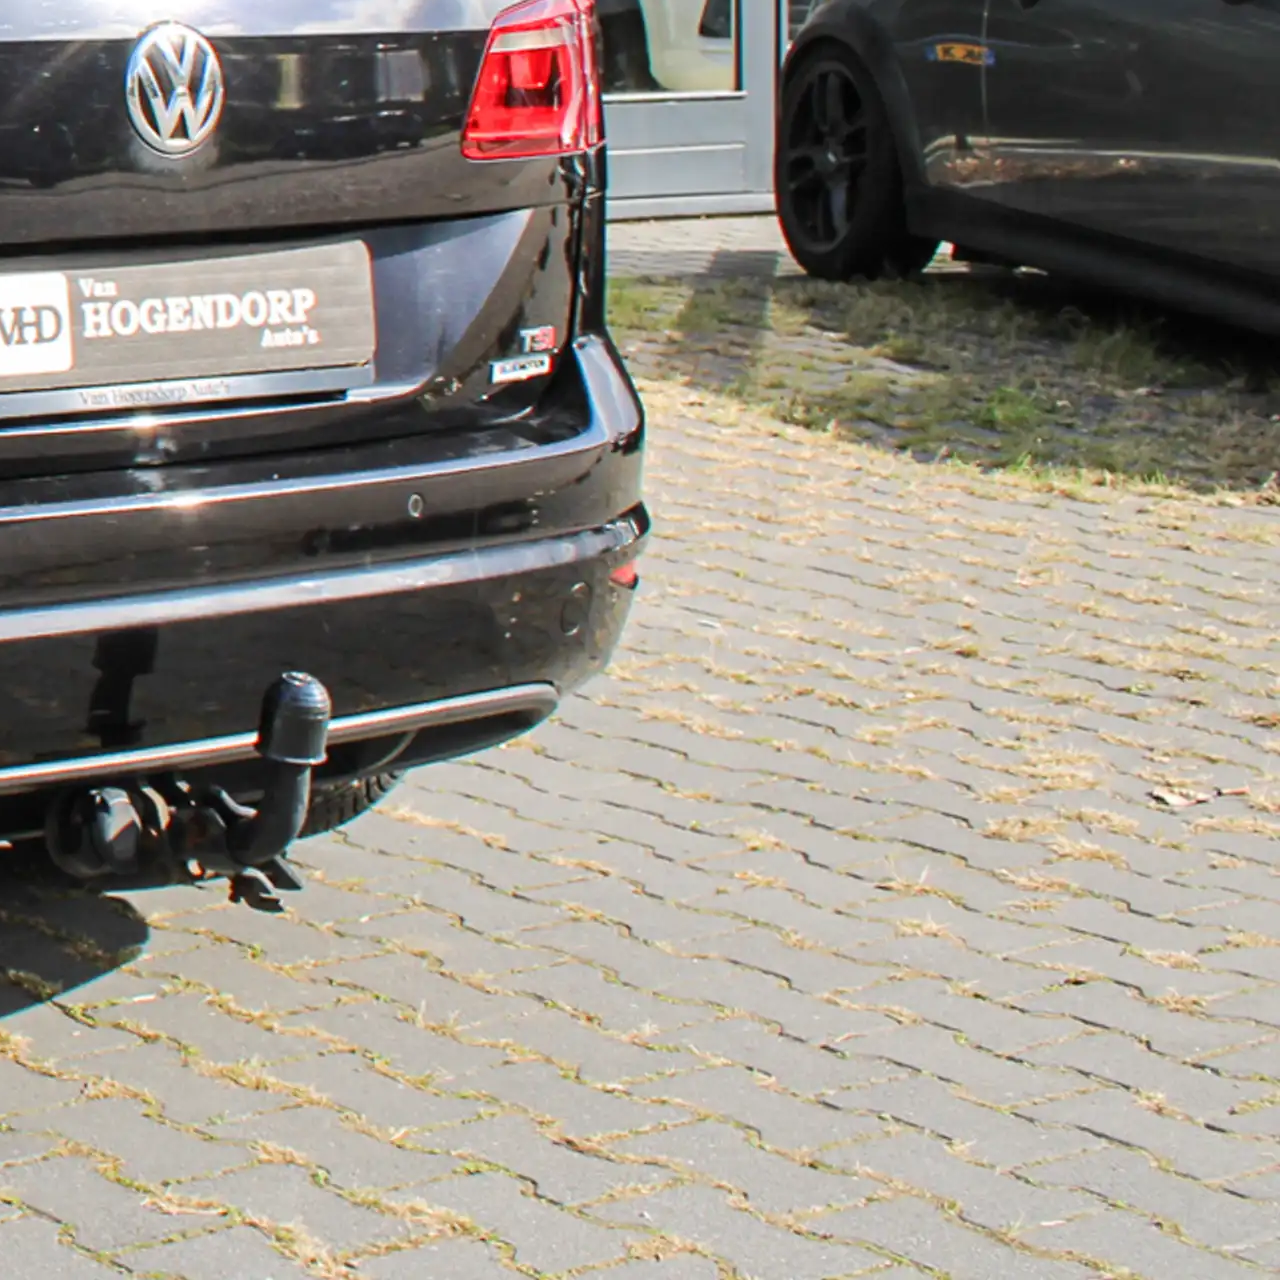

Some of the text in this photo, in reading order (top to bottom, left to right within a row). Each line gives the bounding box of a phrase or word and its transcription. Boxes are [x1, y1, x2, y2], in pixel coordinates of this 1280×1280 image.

[78, 278, 118, 298] Van
[81, 287, 318, 339] HOGENDORP
[260, 326, 321, 349] Auto's
